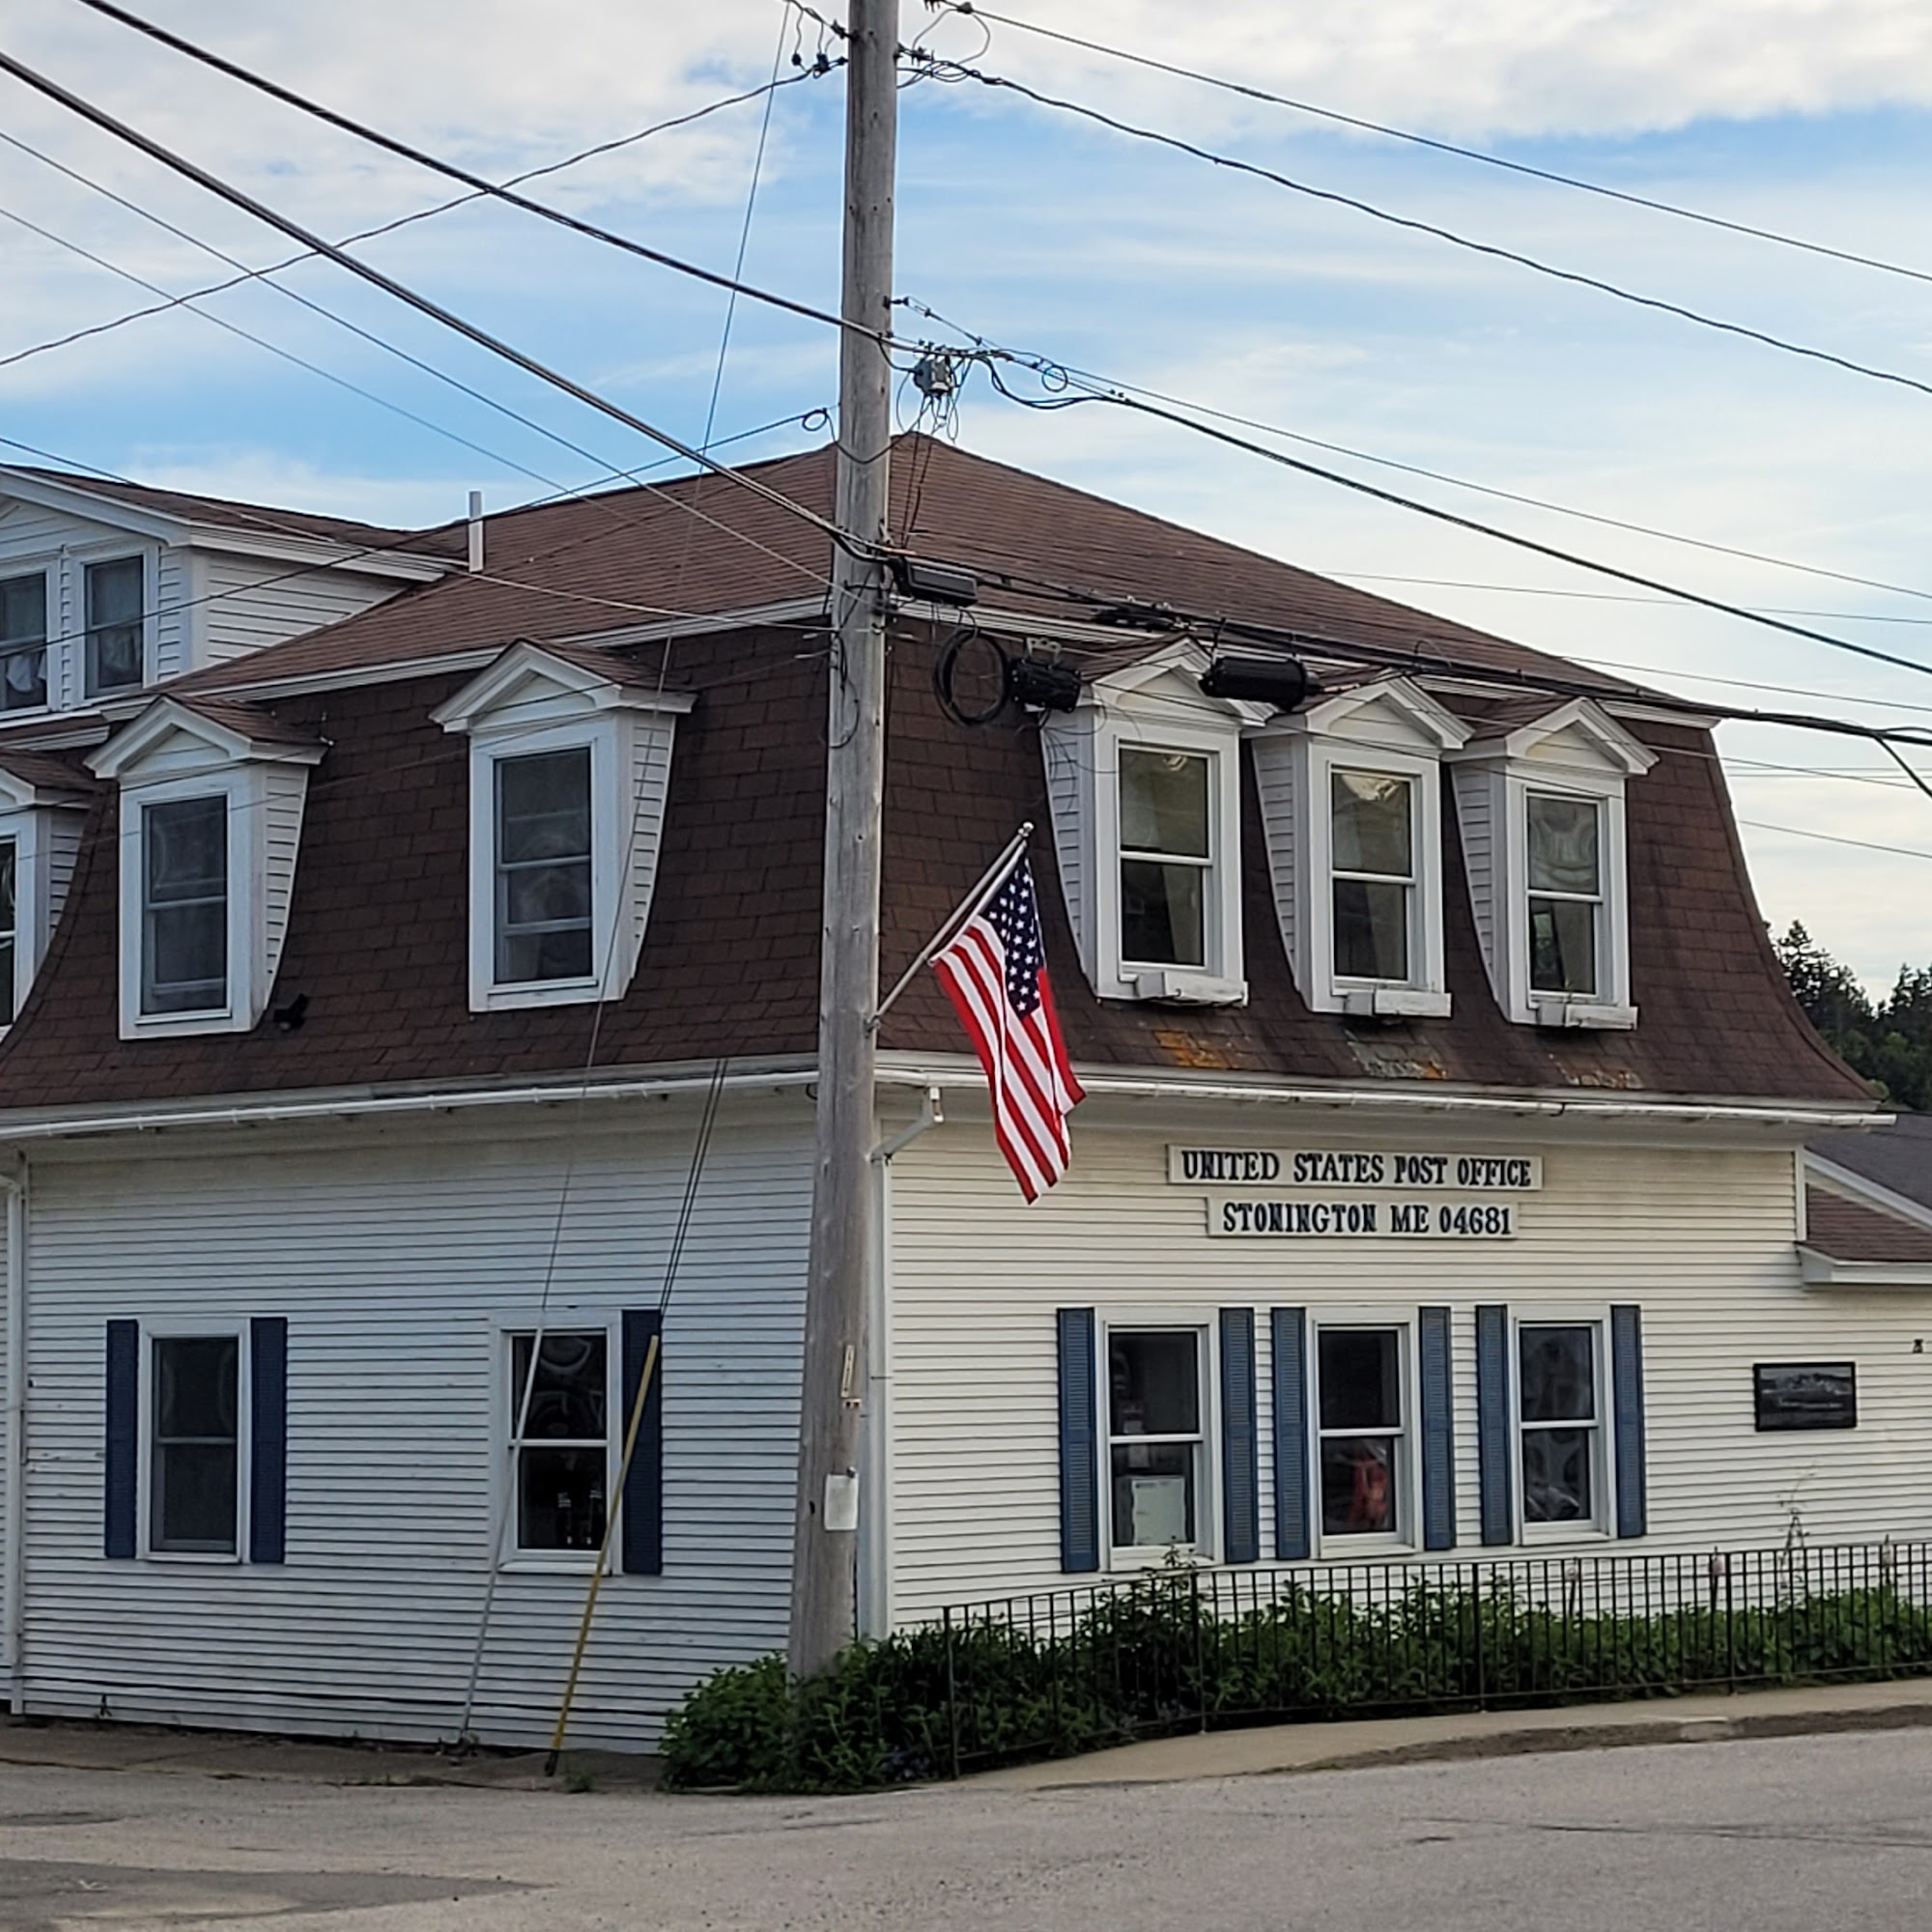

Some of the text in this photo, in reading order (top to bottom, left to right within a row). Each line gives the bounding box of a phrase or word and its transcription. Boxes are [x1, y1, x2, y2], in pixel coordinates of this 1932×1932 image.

[1181, 1150, 1531, 1187] UNITED STATES POST OFFICE
[1223, 1202, 1512, 1236] STONINGTON ME 04681
